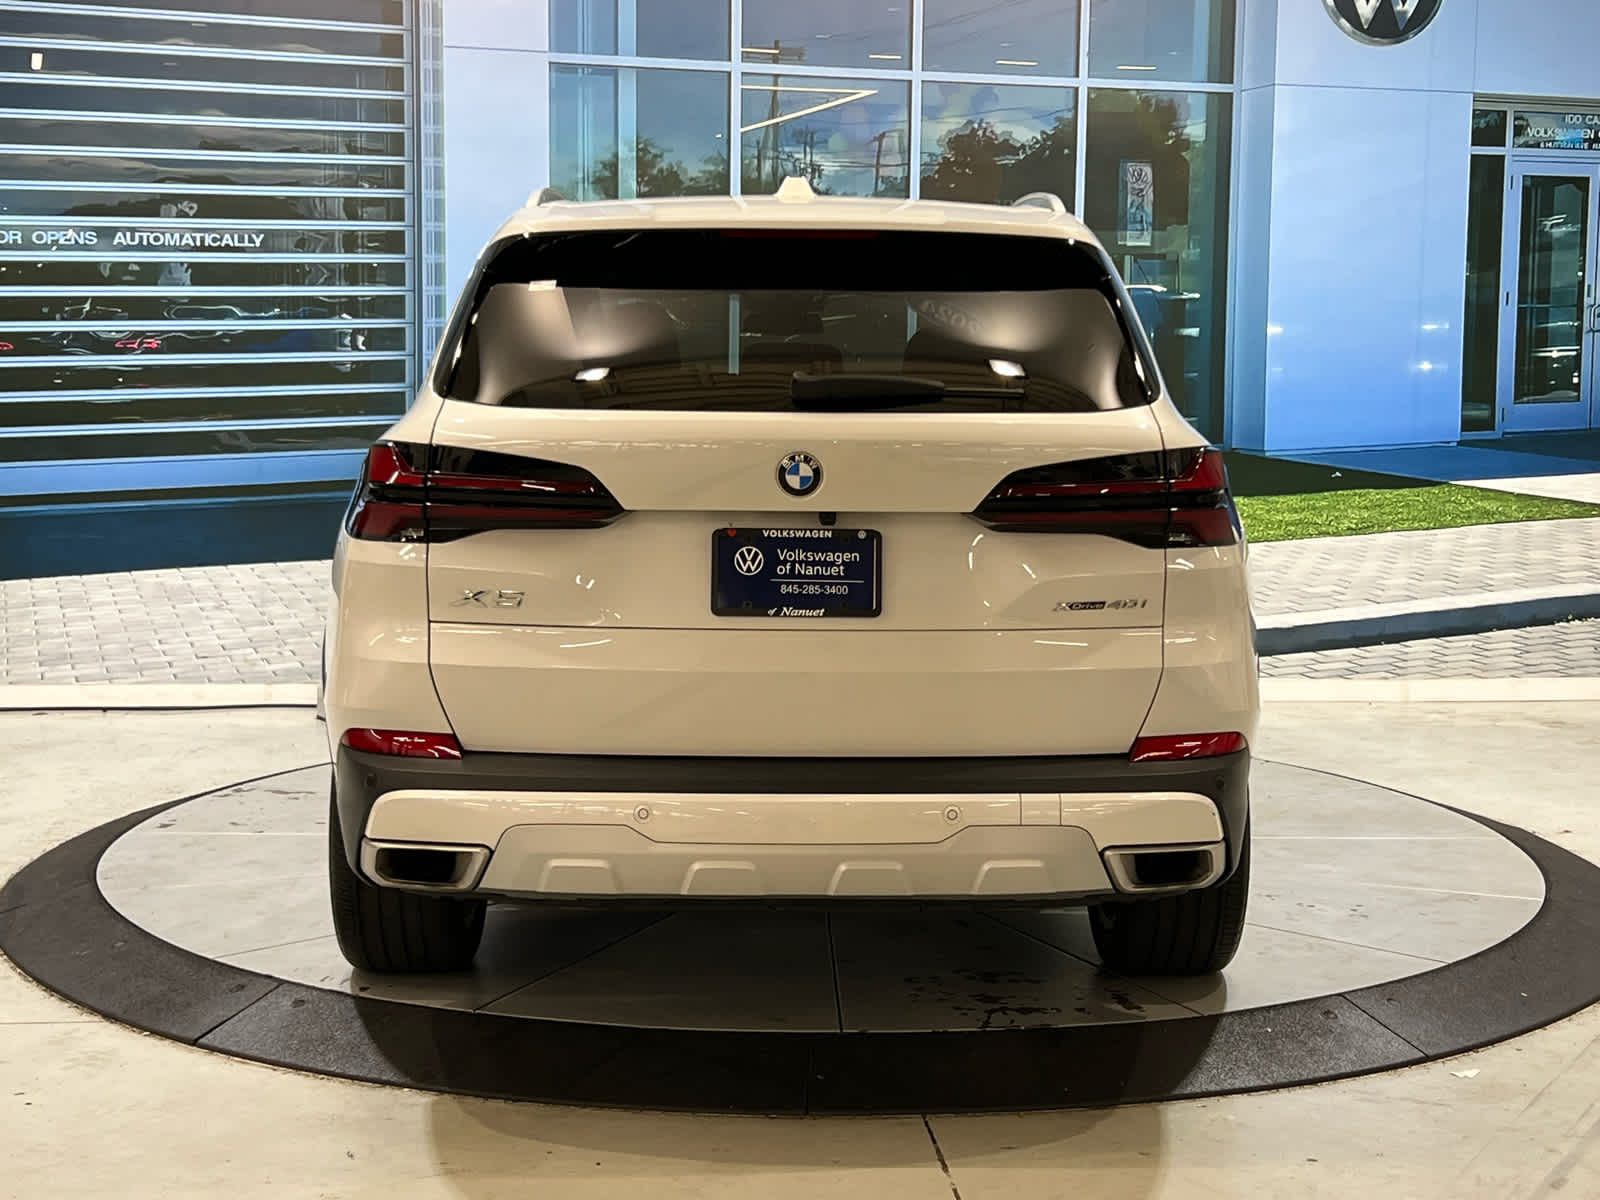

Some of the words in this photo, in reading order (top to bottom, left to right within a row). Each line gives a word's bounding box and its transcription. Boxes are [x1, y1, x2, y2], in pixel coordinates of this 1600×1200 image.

[31, 230, 98, 245] OPENS
[112, 231, 265, 247] AUTOMATICALLY
[762, 529, 832, 538] VOLKSWAGEN
[776, 549, 860, 564] Volkswagen
[776, 563, 791, 575] of
[795, 563, 845, 576] Nanuet
[780, 584, 849, 595] 845-285-3400
[767, 607, 777, 617] of
[780, 607, 825, 617] Nanuet
